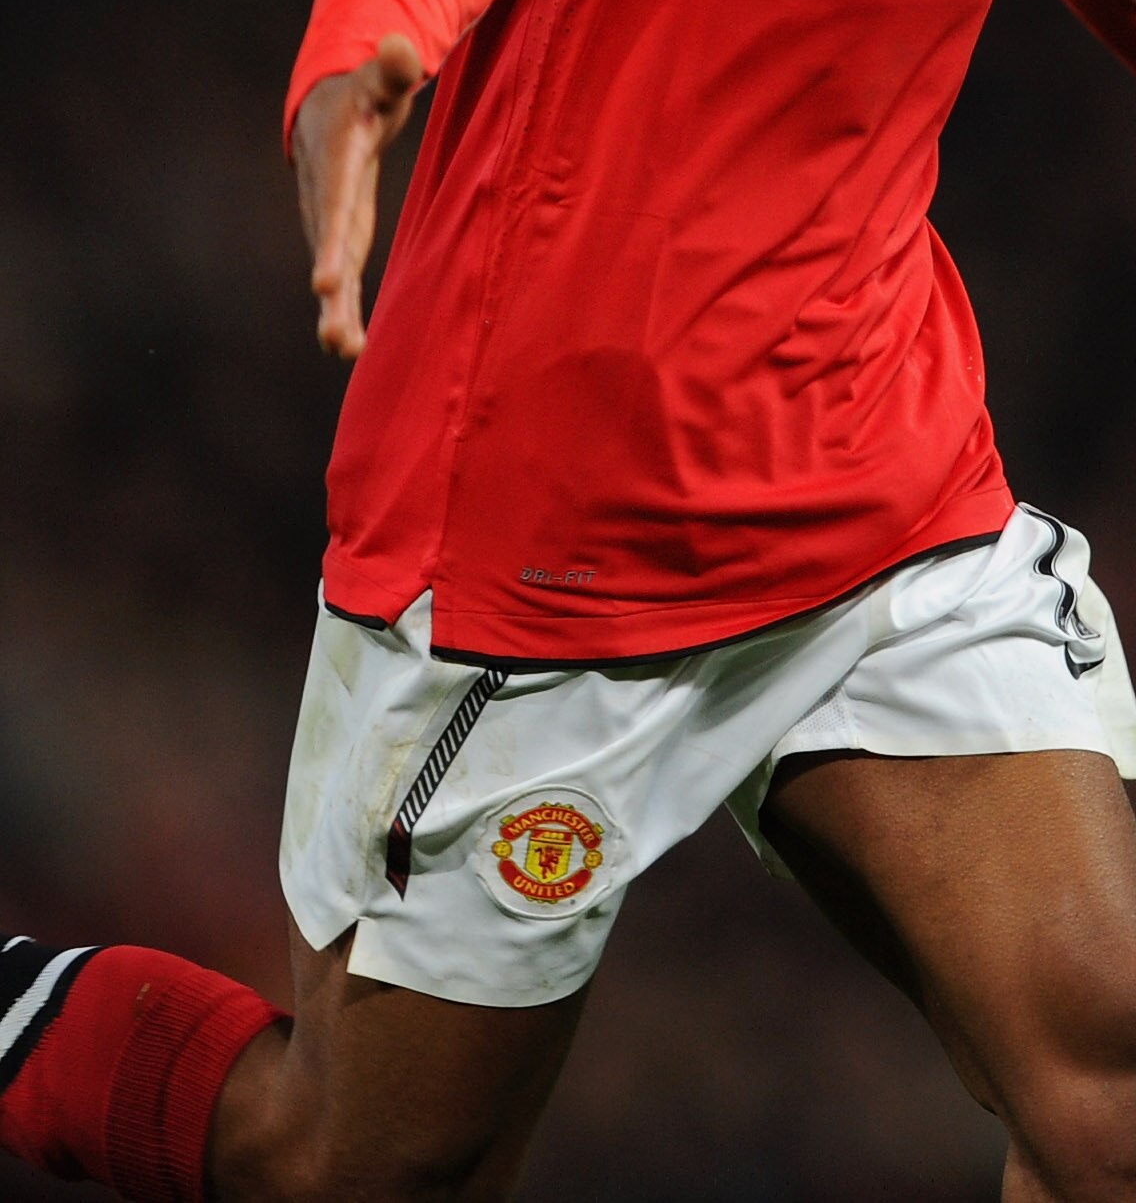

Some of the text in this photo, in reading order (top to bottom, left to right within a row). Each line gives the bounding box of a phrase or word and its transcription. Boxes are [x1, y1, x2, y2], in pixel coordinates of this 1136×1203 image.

[520, 567, 596, 584] DRI-FIT
[508, 810, 595, 844] MANCHESTER
[513, 876, 576, 897] UNITED
